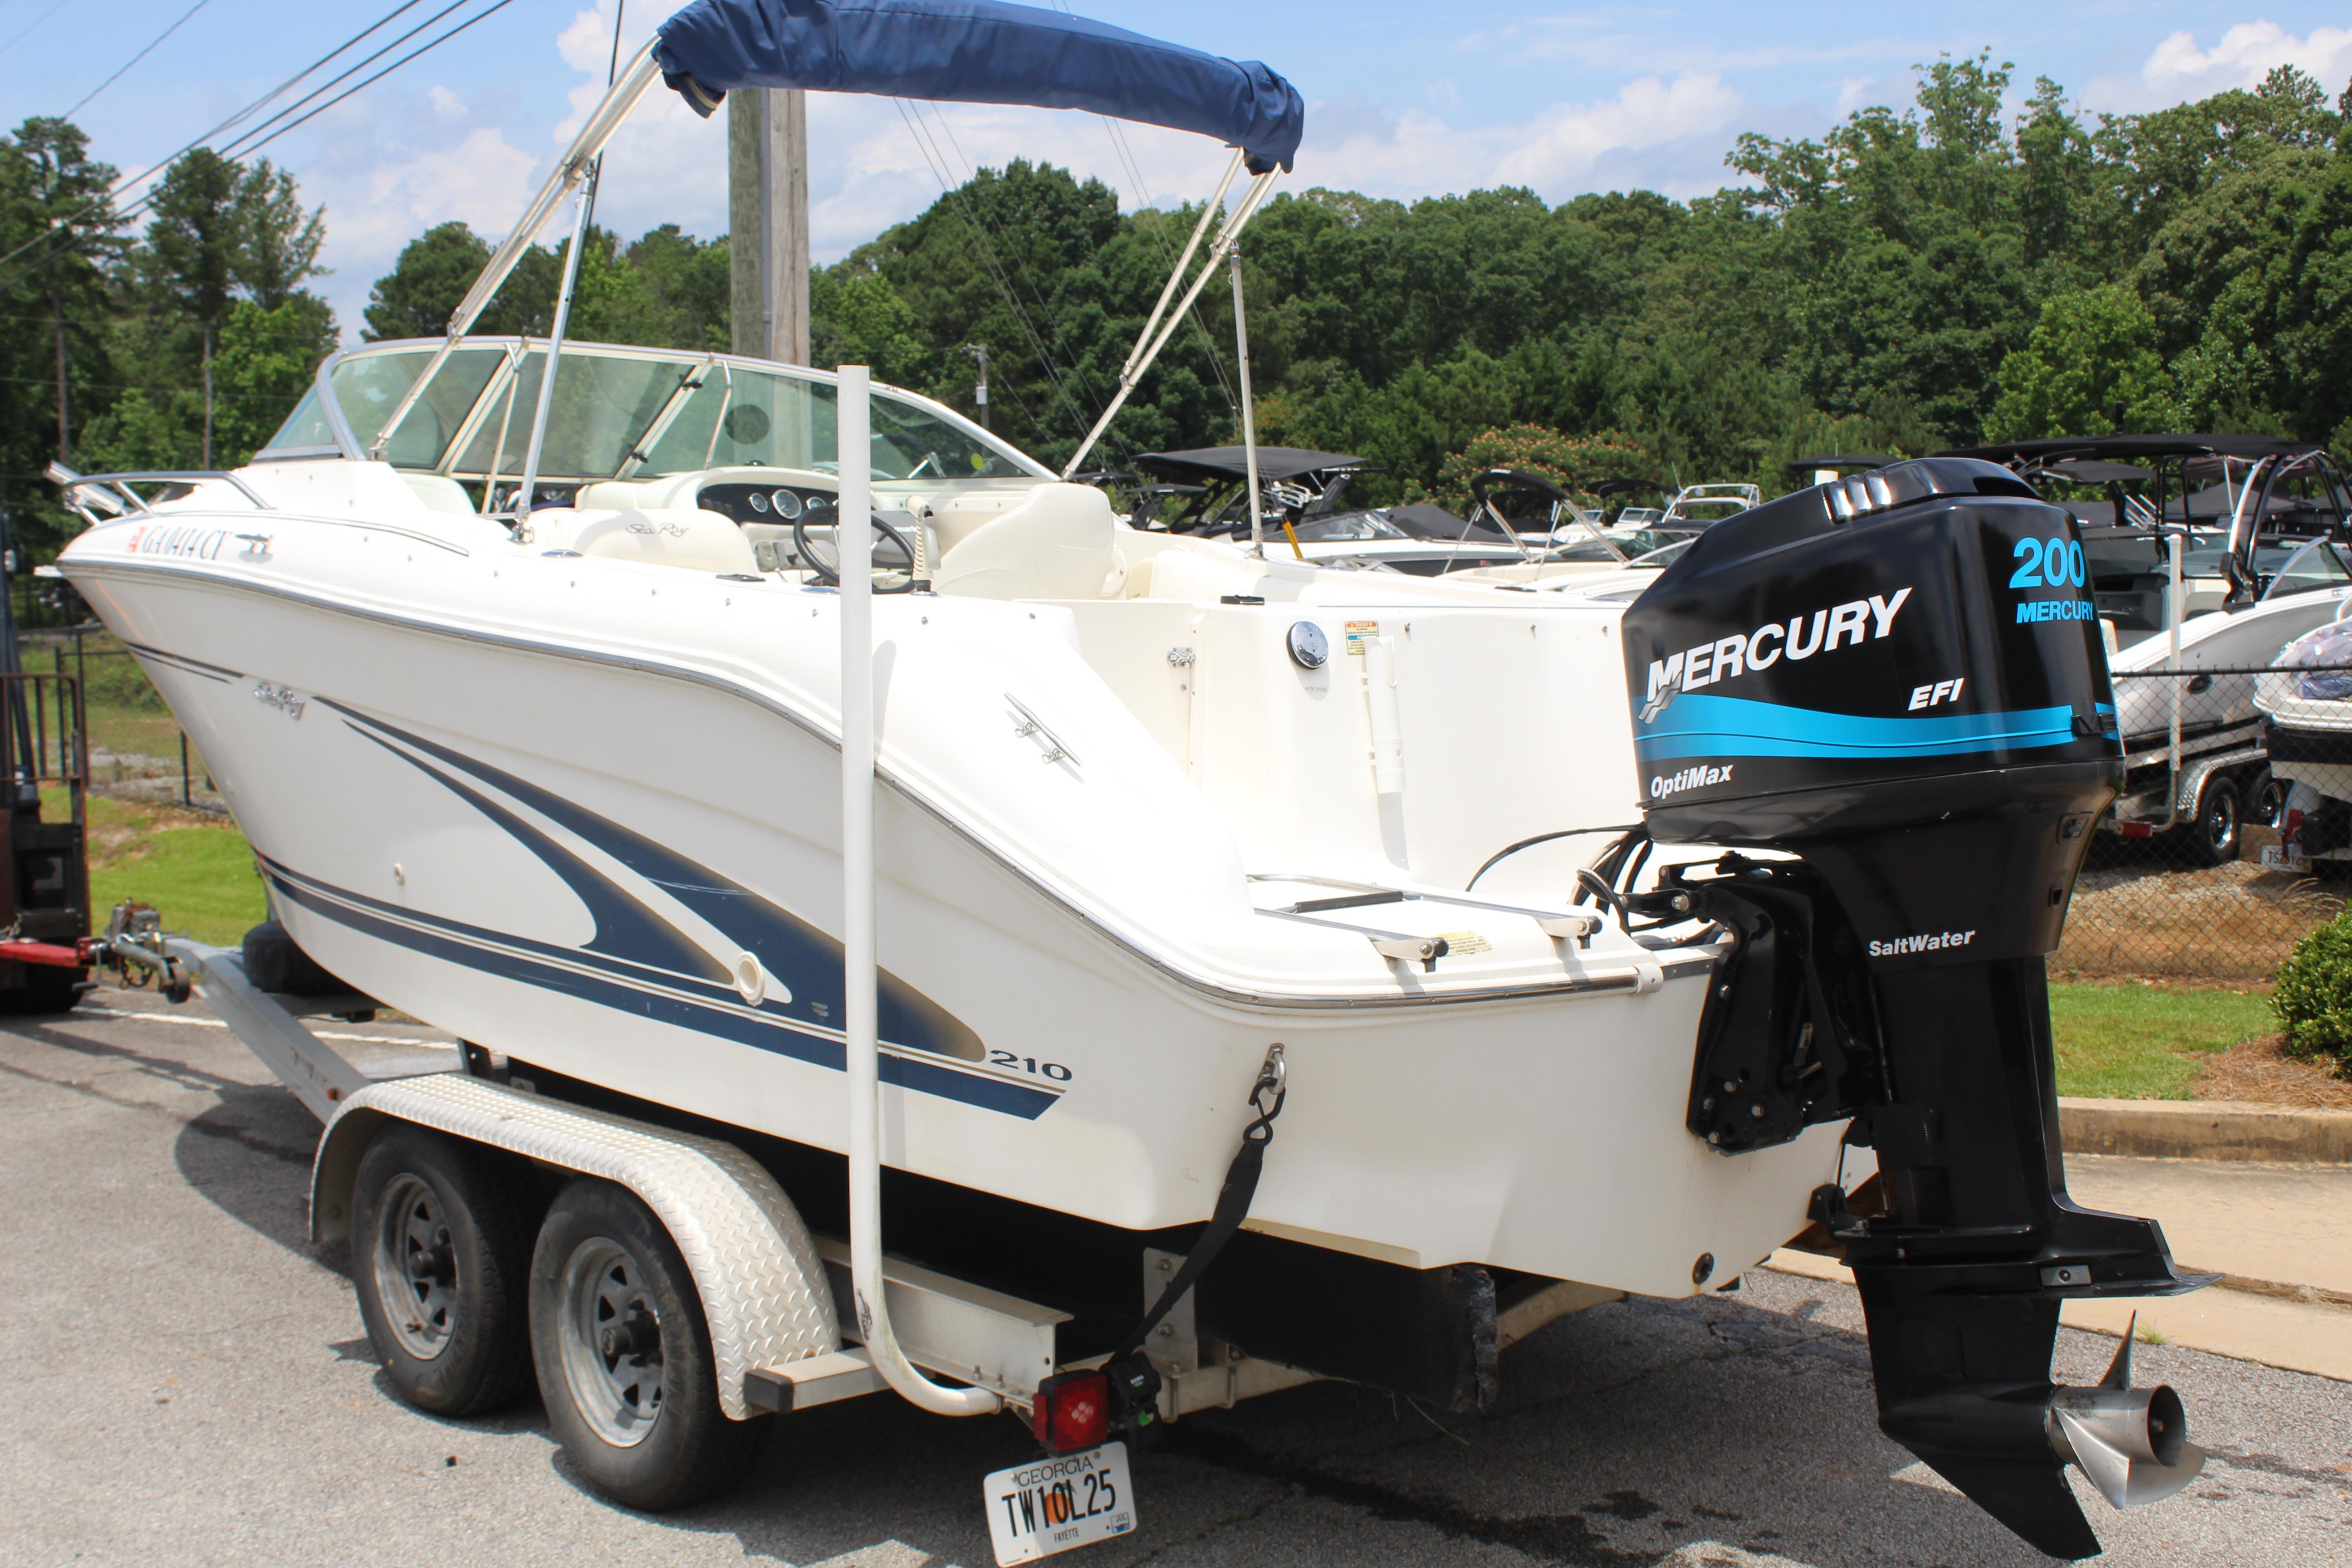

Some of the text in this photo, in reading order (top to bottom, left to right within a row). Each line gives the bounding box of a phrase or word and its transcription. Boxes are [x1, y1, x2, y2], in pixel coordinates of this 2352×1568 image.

[626, 523, 690, 537] Sea Ray
[2009, 537, 2085, 588] 200
[2016, 600, 2093, 623] MERCURY
[1646, 587, 1913, 702] MERCURY
[1908, 678, 1965, 711] EFI
[1651, 764, 1733, 800] OptiMax
[1869, 930, 1975, 957] SaltWater
[990, 1050, 1072, 1081] 210
[1018, 1456, 1093, 1487] GEORGIA
[1001, 1468, 1116, 1538] TW10L25
[1054, 1528, 1080, 1543] FAYETTE
